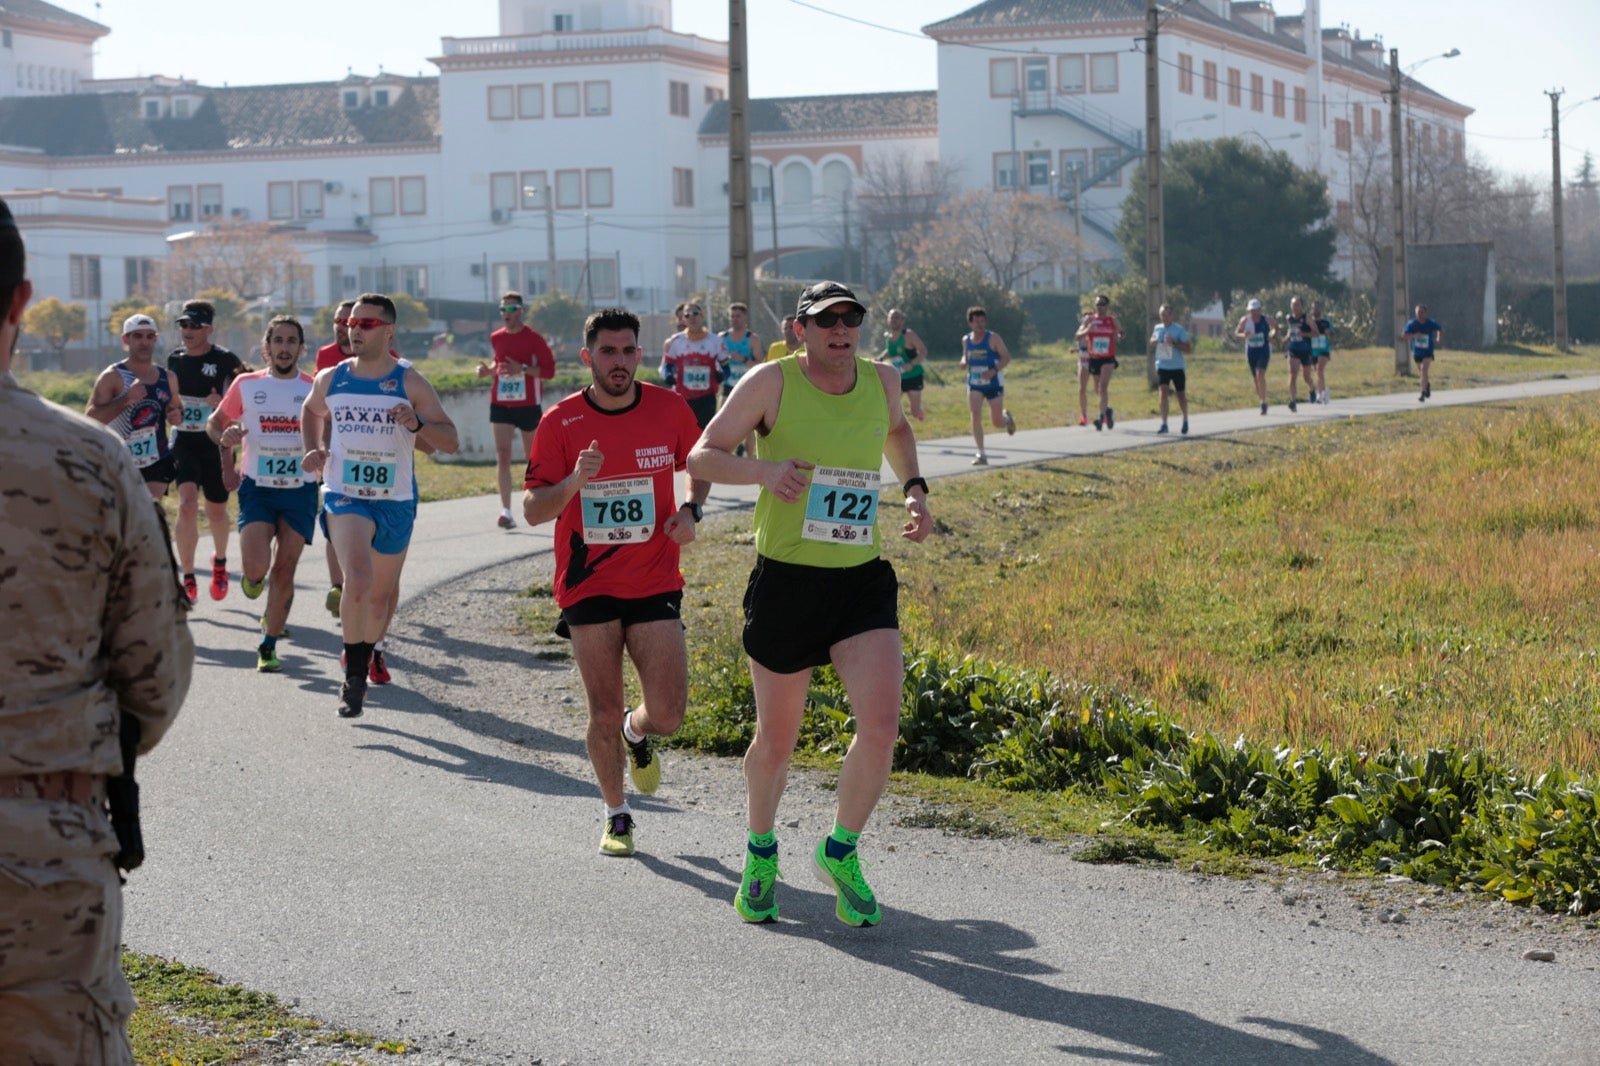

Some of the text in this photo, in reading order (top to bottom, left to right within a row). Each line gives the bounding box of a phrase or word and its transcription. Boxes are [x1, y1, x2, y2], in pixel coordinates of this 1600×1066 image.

[334, 410, 396, 425] CAXAR
[635, 445, 669, 458] RUNNING
[266, 459, 298, 475] 124
[351, 464, 388, 484] 198
[832, 469, 846, 478] GRAN
[846, 470, 864, 480] PREMIO
[864, 472, 871, 481] DE
[609, 481, 627, 489] PREMIO
[837, 478, 867, 489] DIPUTACIÓN
[603, 488, 630, 497] DIPUTACIÓN
[593, 498, 643, 524] 768
[824, 490, 872, 521] 122
